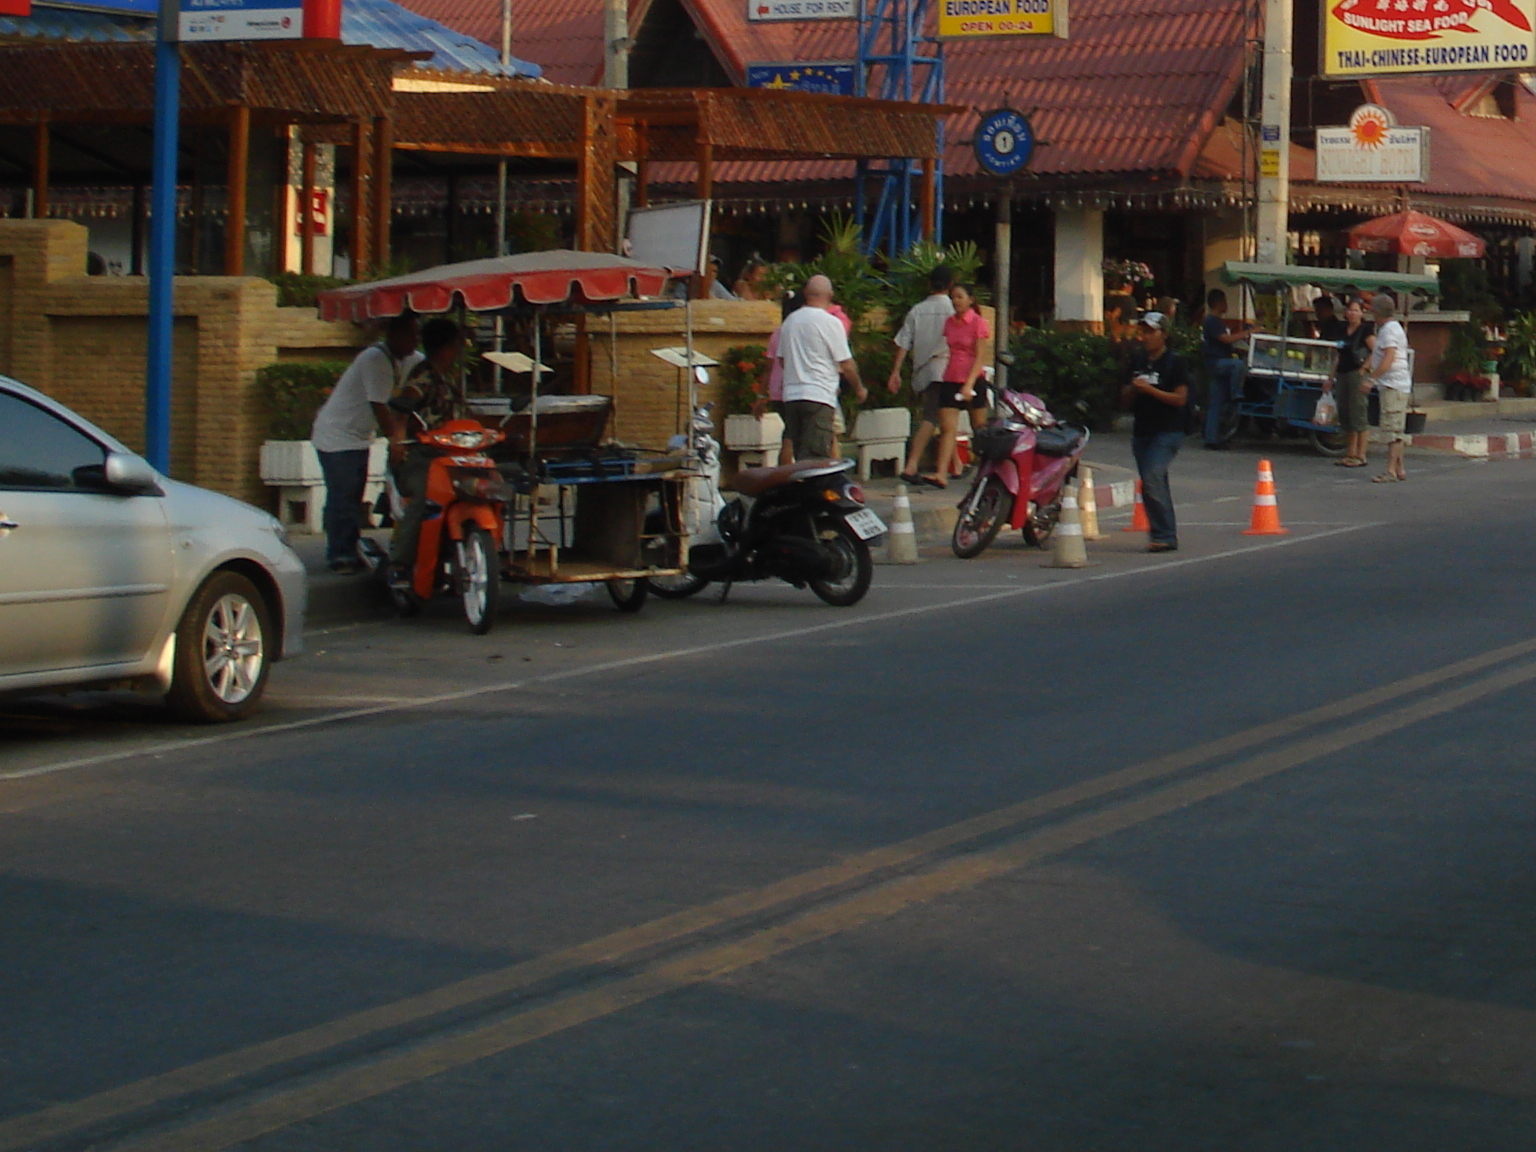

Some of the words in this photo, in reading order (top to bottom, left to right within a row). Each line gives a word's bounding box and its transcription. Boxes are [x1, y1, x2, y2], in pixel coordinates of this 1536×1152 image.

[774, 3, 802, 14] HOUSE
[806, 3, 823, 13] FOR
[827, 2, 850, 13] RENT
[946, 0, 1010, 16] EUROPEAN
[961, 21, 993, 32] OPEN
[999, 20, 1033, 31] 00-24
[1343, 12, 1406, 33] SUNLIGHT
[1407, 18, 1432, 33] SEA
[1433, 11, 1468, 30] FOOD
[1338, 43, 1489, 68] THAI-CHINESE-EUROPEAN
[1494, 43, 1528, 62] FOOD
